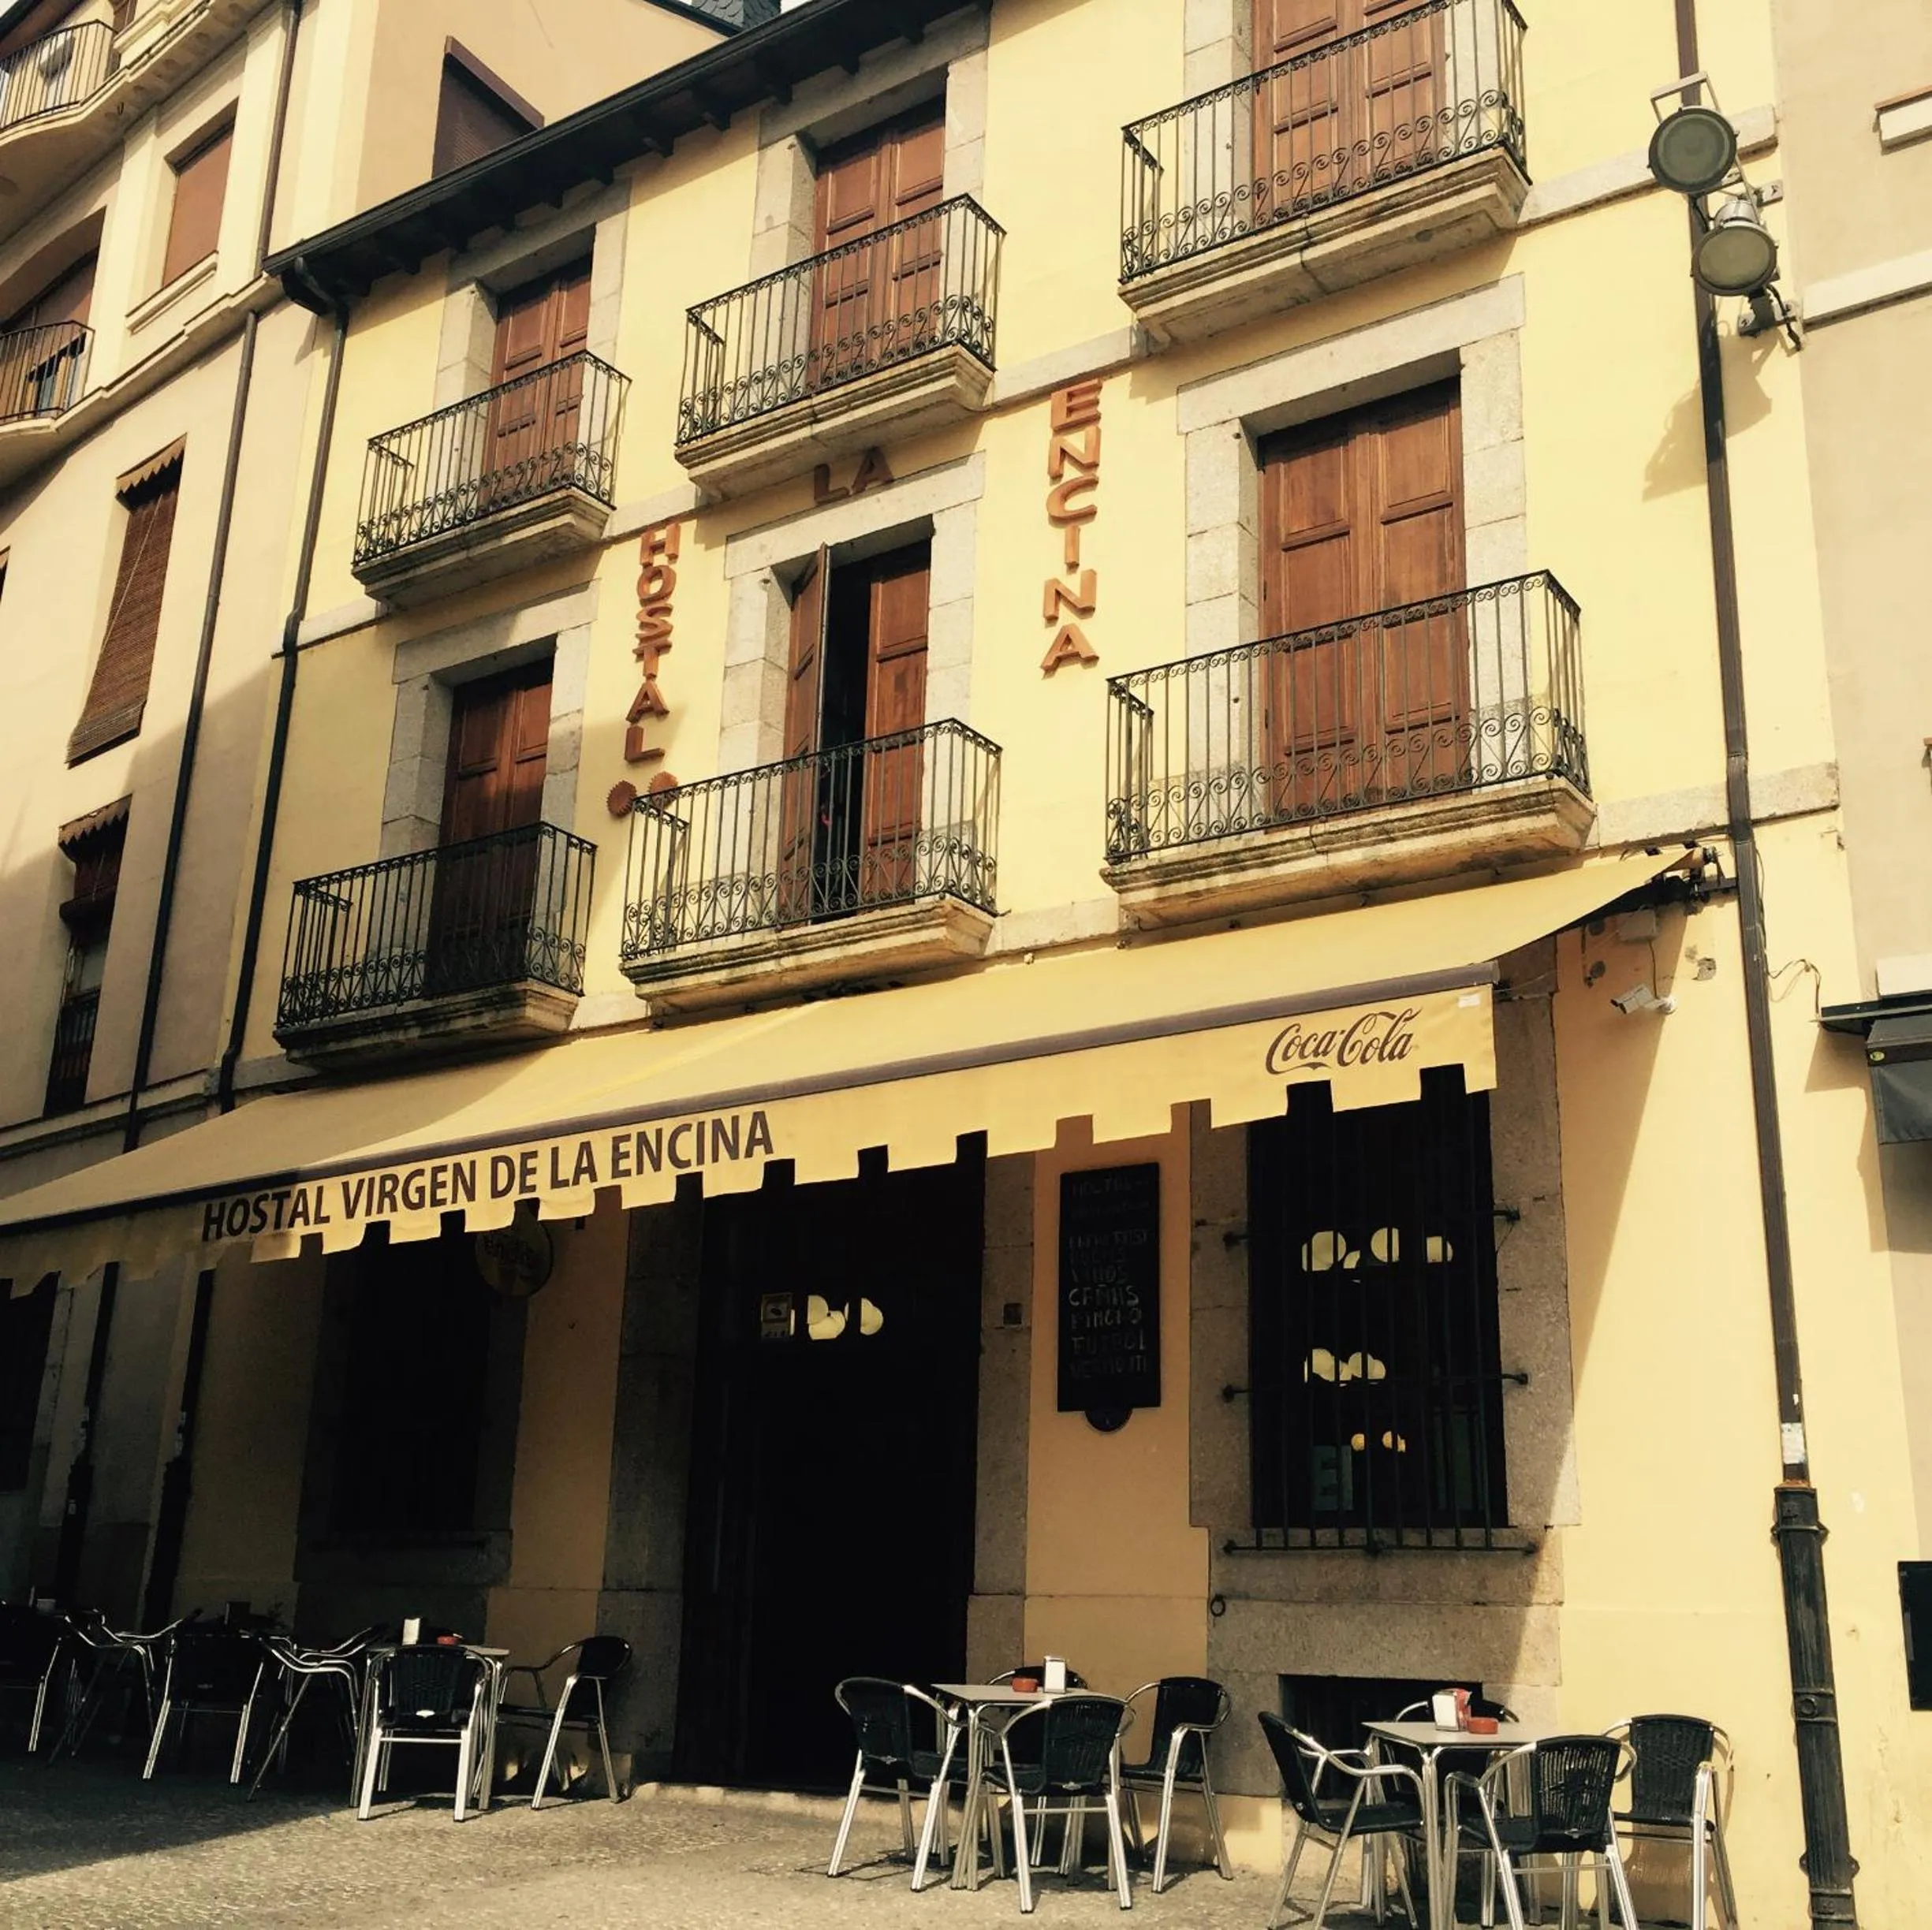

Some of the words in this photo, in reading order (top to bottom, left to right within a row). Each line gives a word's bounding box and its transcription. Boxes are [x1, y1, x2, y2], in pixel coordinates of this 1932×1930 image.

[812, 446, 895, 505] LA
[1039, 378, 1103, 678] ENCINA
[624, 521, 681, 763] HOSTAL
[201, 1185, 330, 1243] HOSTAL
[341, 1159, 476, 1220] VIRGEN
[489, 1150, 538, 1199] DE
[550, 1140, 599, 1190] LA
[611, 1109, 775, 1179] ENCINA
